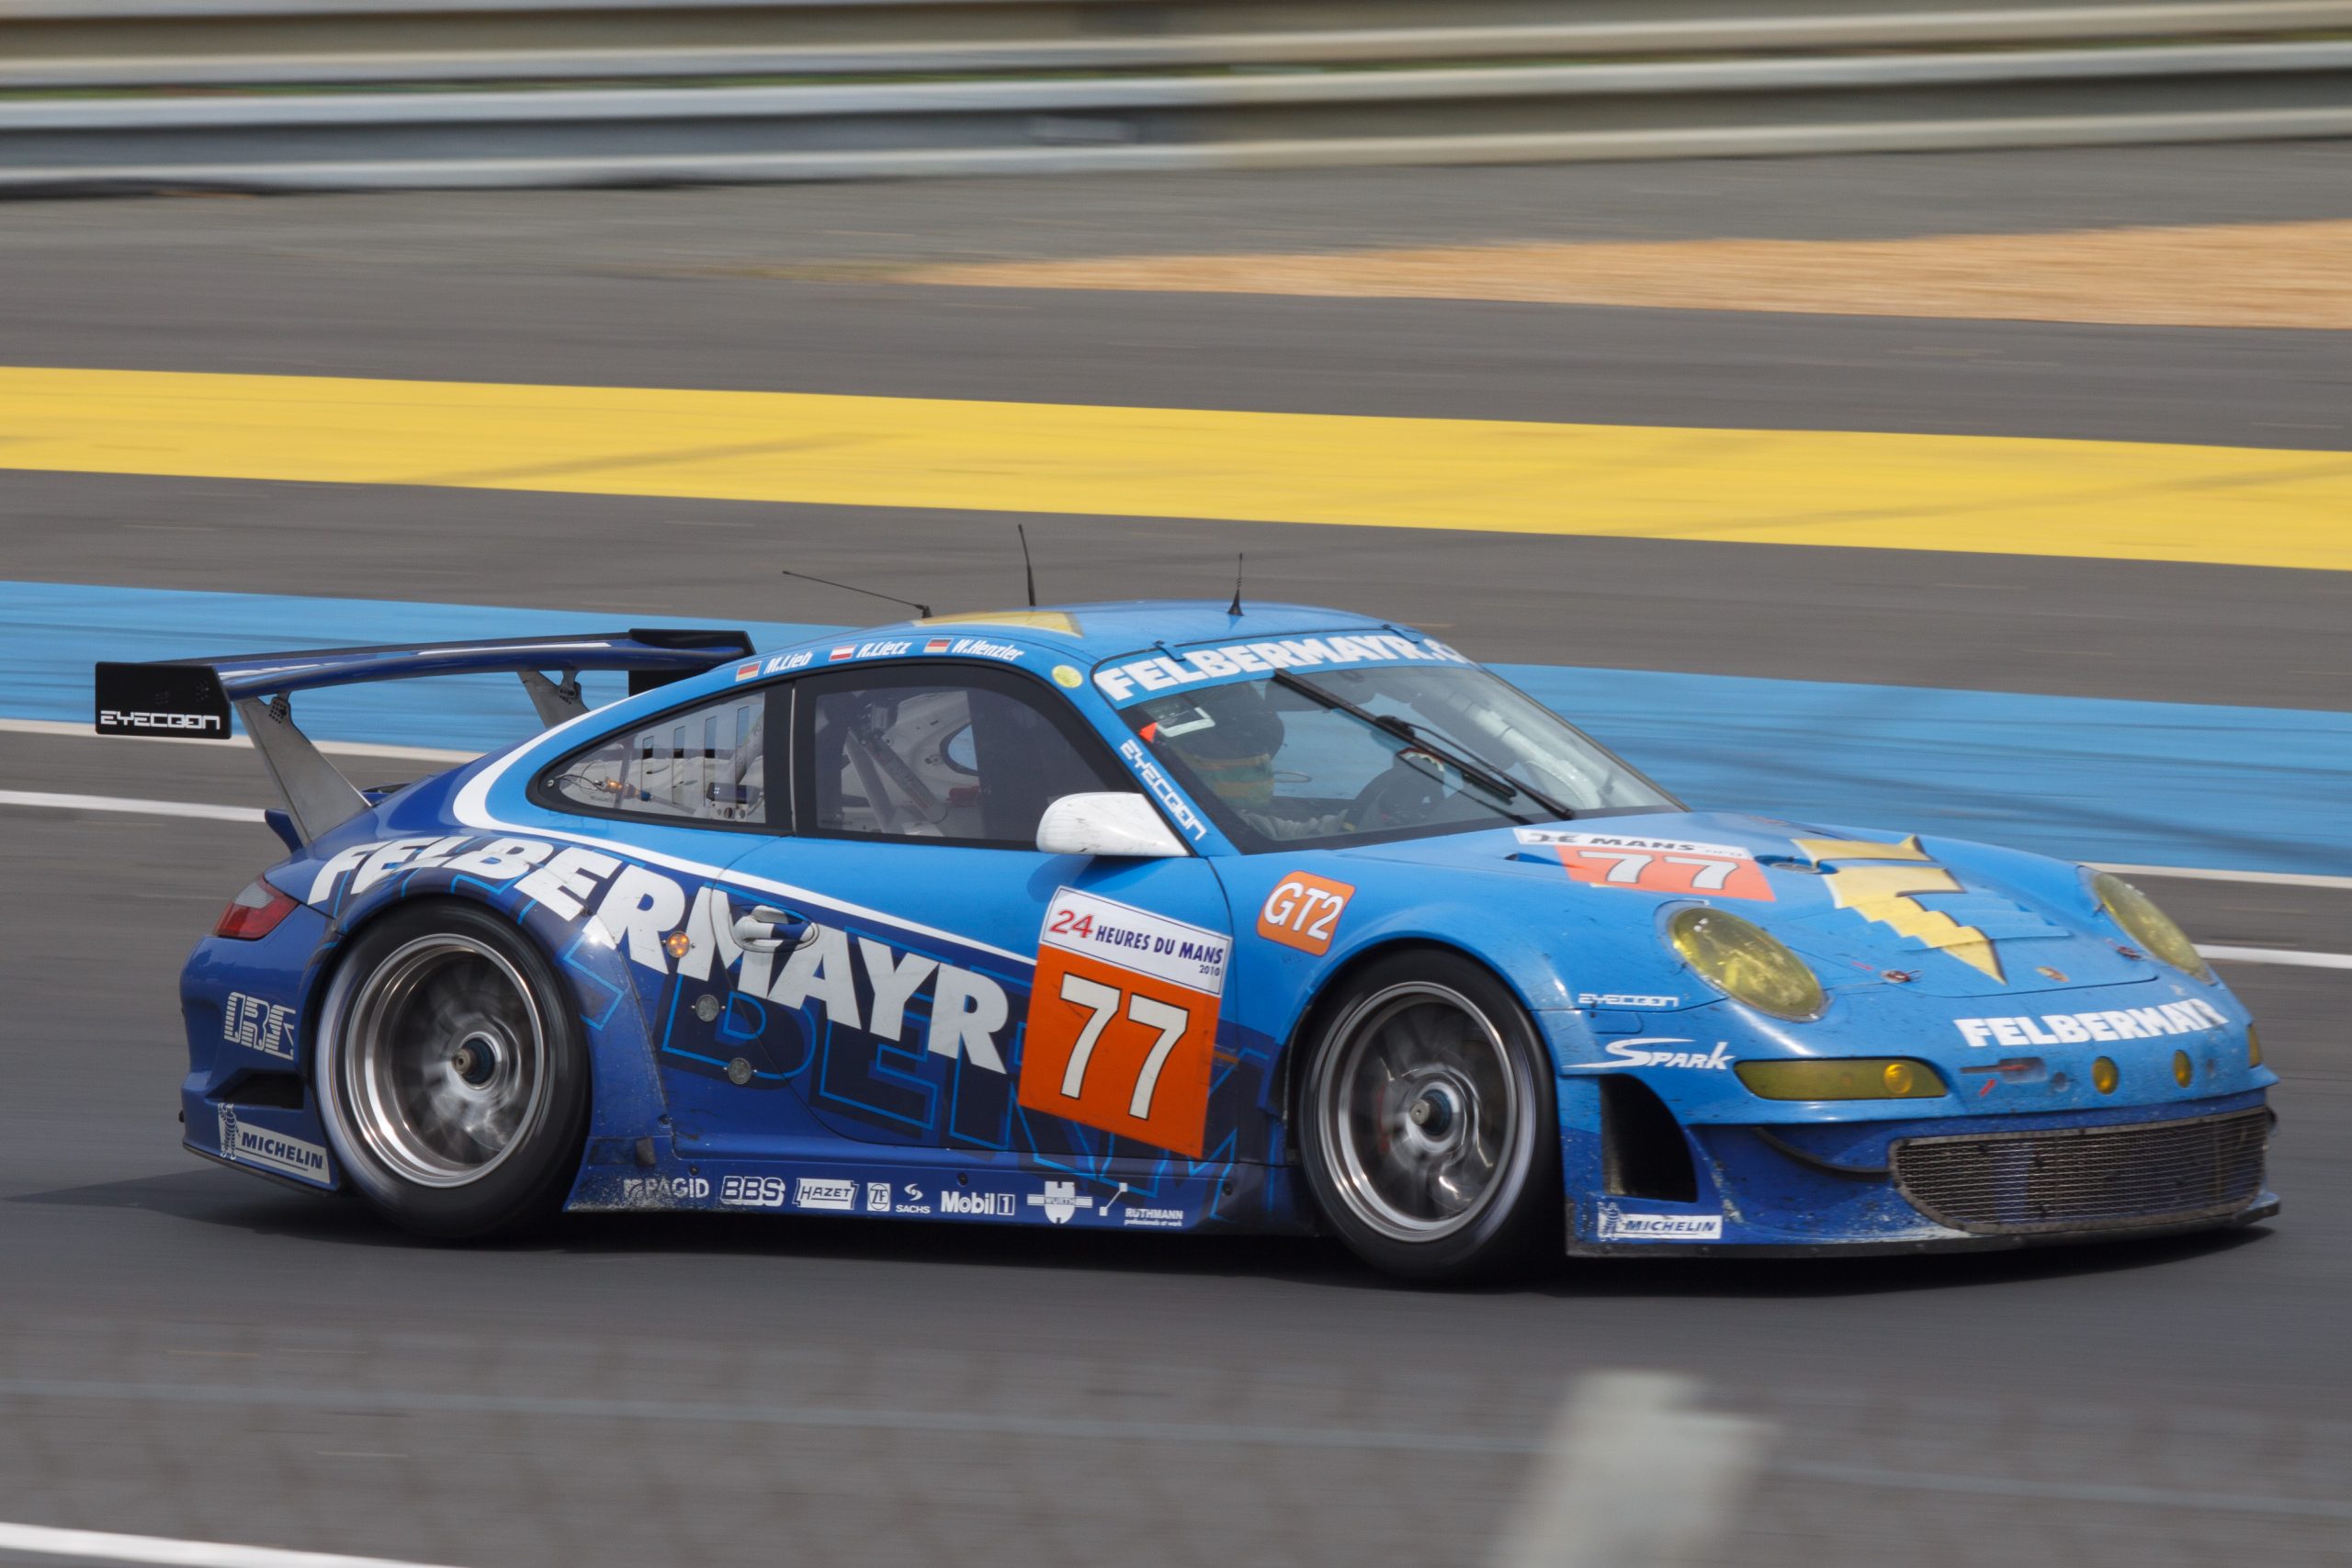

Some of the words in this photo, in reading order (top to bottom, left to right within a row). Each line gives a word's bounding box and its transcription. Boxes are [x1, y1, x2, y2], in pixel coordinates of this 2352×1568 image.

[951, 638, 1024, 661] W.Henzler
[1589, 837, 1697, 852] MANS
[1577, 850, 1741, 890] 77
[1263, 882, 1345, 941] GT2
[1049, 909, 1093, 938] 24
[1095, 925, 1150, 951] HEURES
[1154, 938, 1176, 956] DU
[1179, 942, 1224, 965] MANS
[307, 836, 1010, 1075] FELBERMAYR
[1199, 964, 1221, 977] 2010
[1953, 998, 2230, 1047] FELBERMAYR
[1059, 971, 1191, 1122] 77
[242, 1131, 323, 1169] MICHELIN
[646, 1177, 710, 1199] PAGID
[720, 1176, 786, 1207] BBS
[800, 1184, 853, 1201] HAZET
[870, 1189, 888, 1205] ZF
[895, 1204, 931, 1214] SACHS
[941, 1190, 994, 1214] Mobil
[1624, 1219, 1715, 1232] MICHELIN
